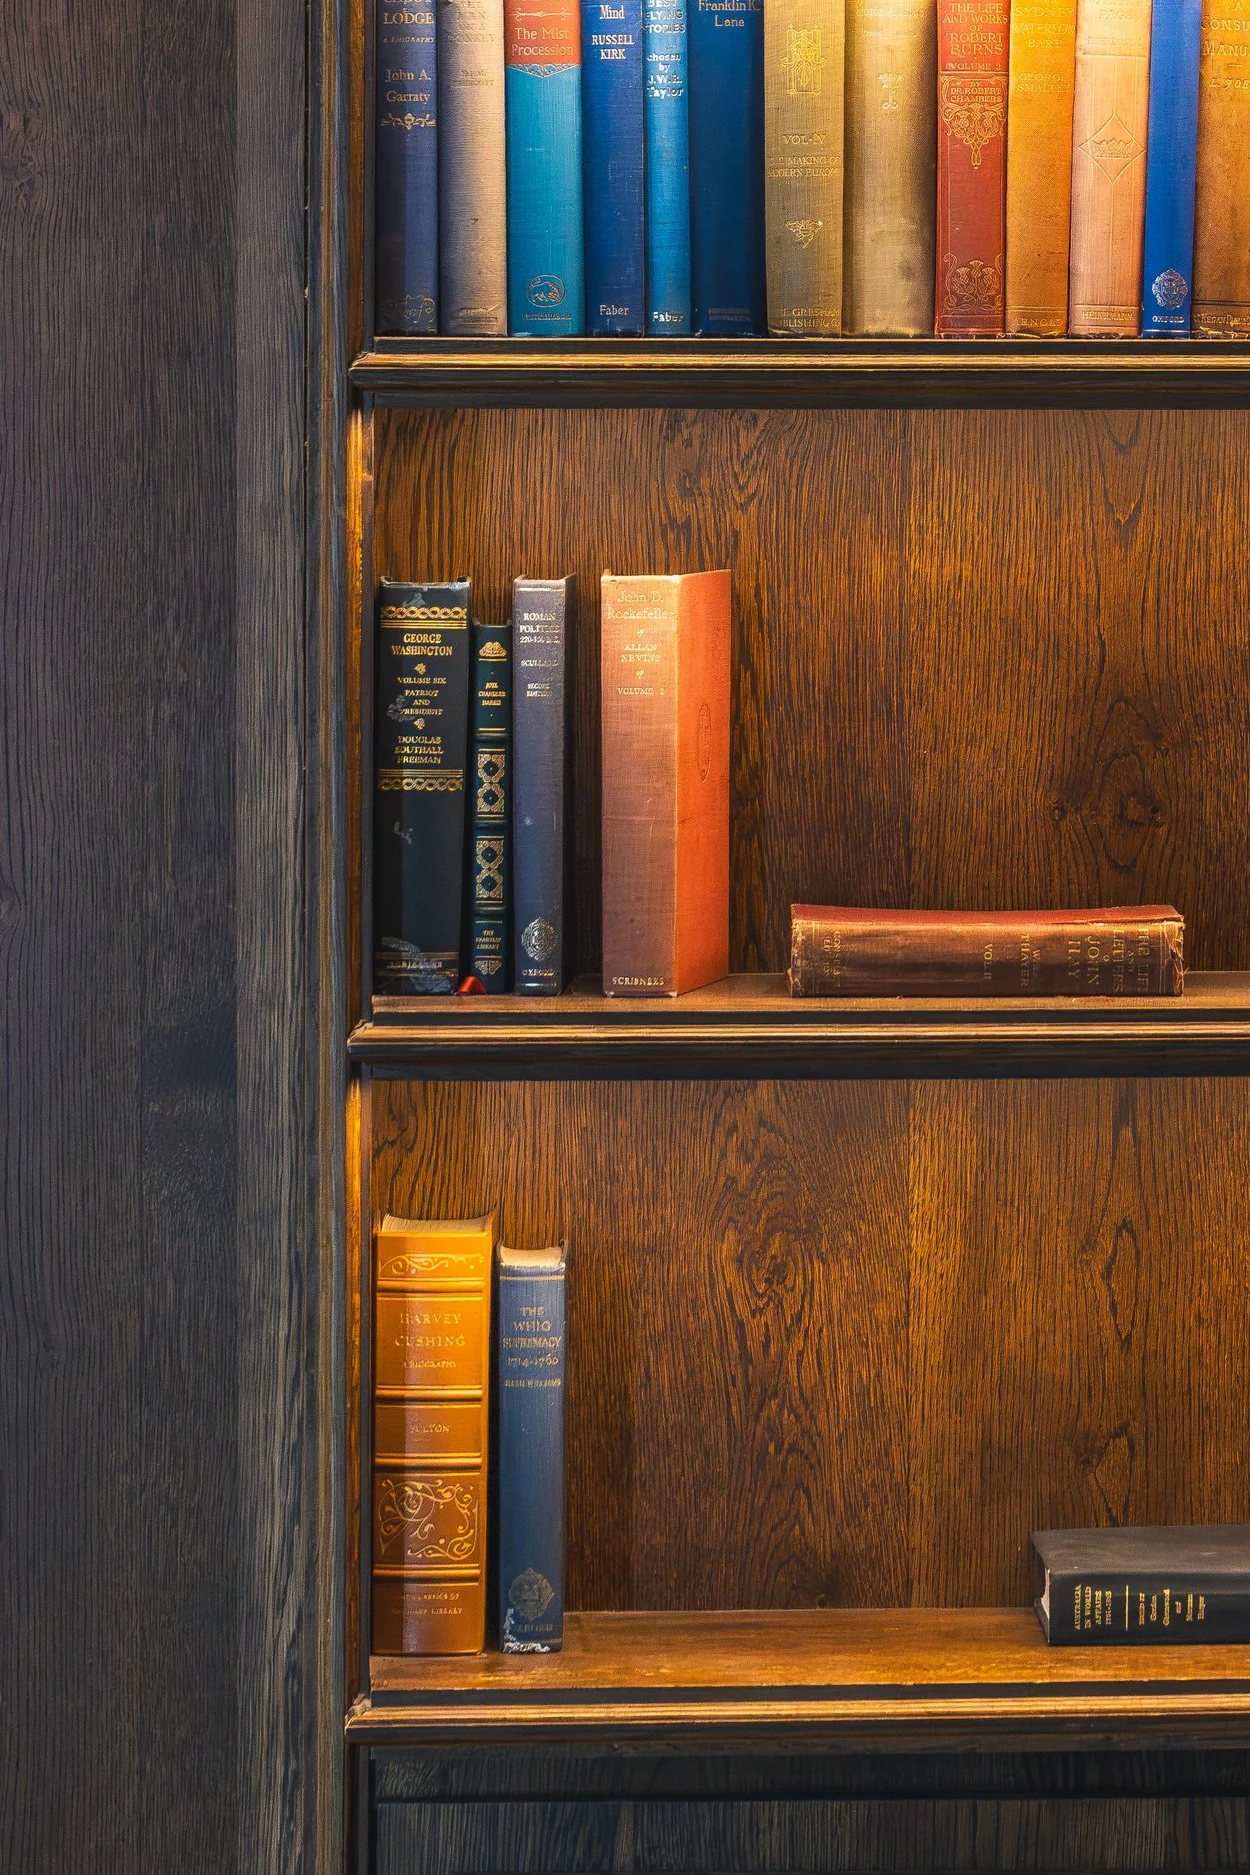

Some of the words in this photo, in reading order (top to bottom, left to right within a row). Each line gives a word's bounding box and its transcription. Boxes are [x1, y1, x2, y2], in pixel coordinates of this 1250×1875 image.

[600, 5, 625, 20] Mind
[949, 3, 973, 13] THE
[978, 3, 1003, 13] LIFE
[1016, 7, 1074, 17] SYDNEY
[383, 11, 434, 26] LODGE
[714, 15, 744, 28] Lane
[943, 15, 967, 23] AND
[971, 15, 1008, 23] WORKS
[515, 27, 537, 40] The
[541, 27, 569, 40] Mist
[949, 33, 1003, 43] ROBERT
[592, 34, 634, 46] RUSSELL
[511, 43, 574, 57] Procession
[600, 47, 626, 60] KIRK
[951, 45, 1003, 55] BURNS
[385, 68, 412, 82] John
[416, 69, 431, 81] A.
[386, 89, 431, 105] Garraty
[647, 85, 683, 99] Taylor
[599, 304, 629, 317] Faber
[403, 633, 442, 644] GEORGE
[392, 645, 453, 657] WASHINGTON
[398, 736, 441, 744] DOUGLAS
[612, 977, 664, 986] SCRIBNERS
